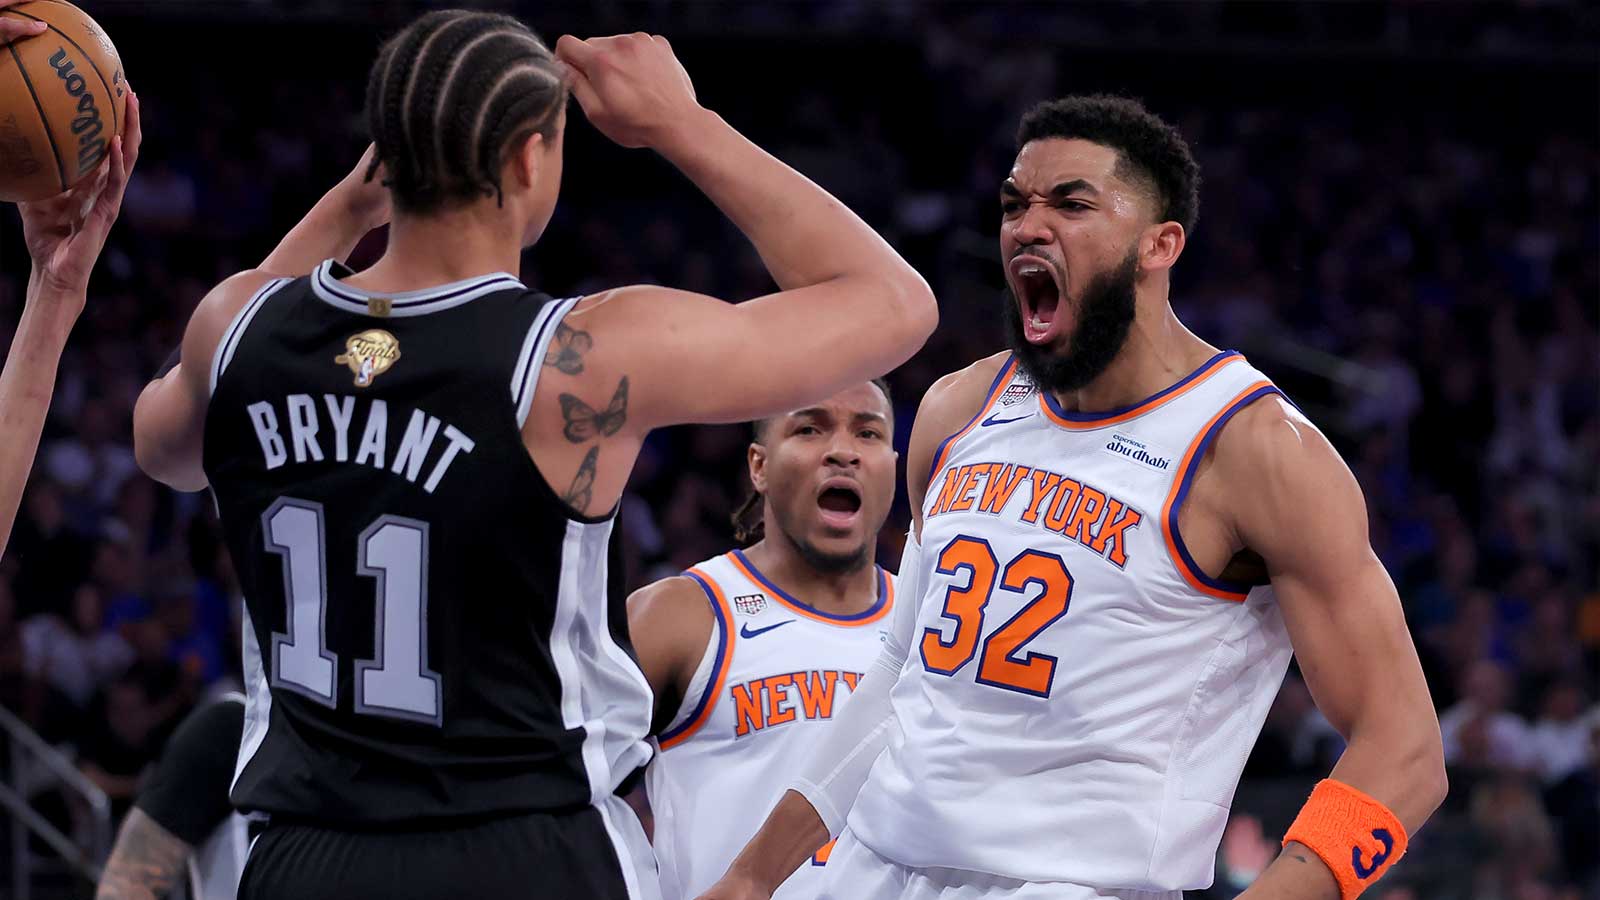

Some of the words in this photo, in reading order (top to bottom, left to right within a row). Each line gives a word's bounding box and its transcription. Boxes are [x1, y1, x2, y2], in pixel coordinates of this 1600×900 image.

[48, 46, 106, 176] Wilson
[247, 393, 476, 494] BRYANT
[1106, 440, 1132, 457] abu
[1132, 449, 1172, 470] dhabi
[1112, 433, 1147, 449] experience
[928, 462, 1029, 518] NEW
[1020, 470, 1143, 569] YORK
[261, 495, 443, 728] 11
[919, 534, 1075, 699] 32
[731, 670, 839, 738] NEW
[1352, 828, 1393, 880] 3
